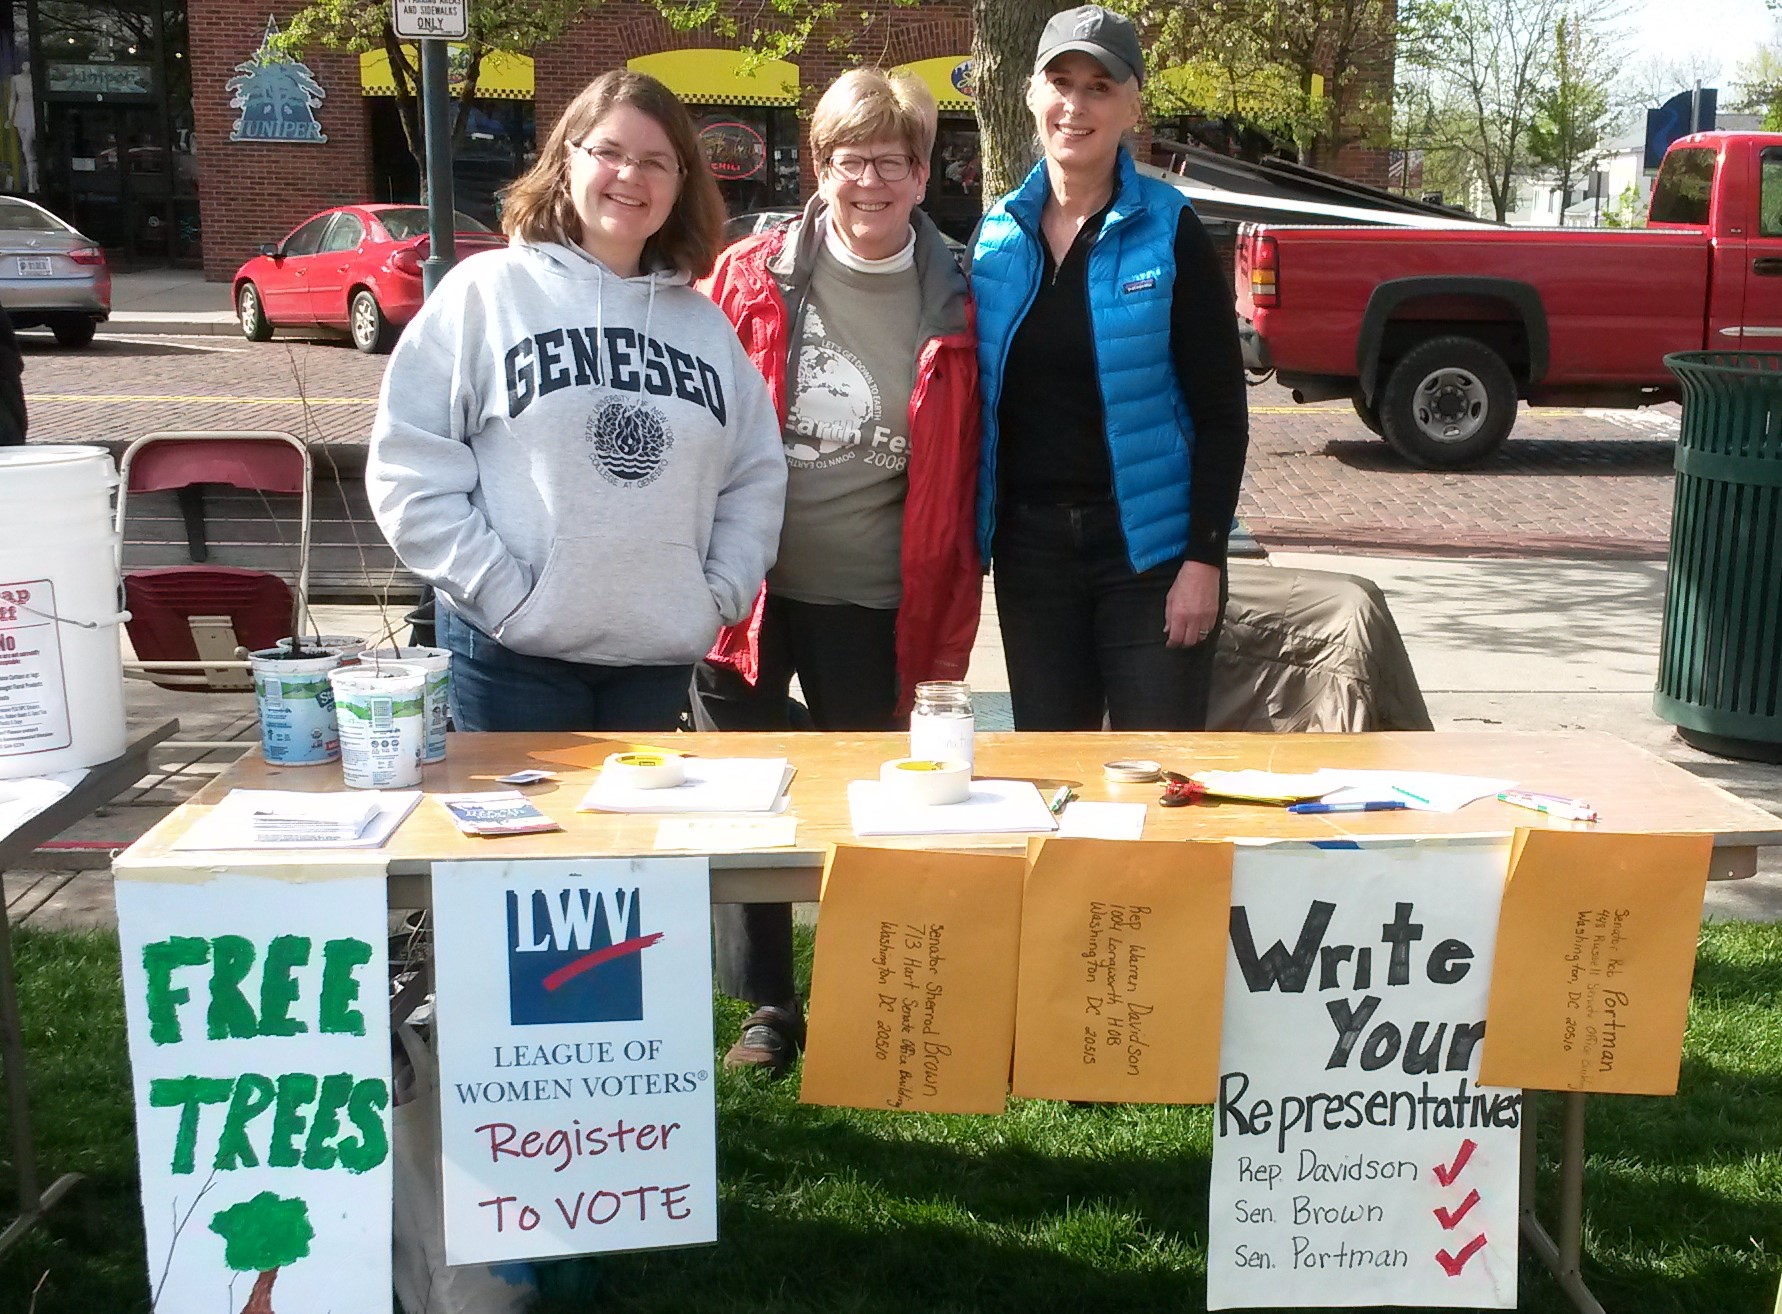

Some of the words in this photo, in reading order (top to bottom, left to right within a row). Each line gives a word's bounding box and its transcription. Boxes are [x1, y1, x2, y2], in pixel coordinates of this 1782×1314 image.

[404, 6, 417, 14] AND
[421, 6, 458, 16] SIDEWALKS
[417, 17, 444, 28] ONLY
[239, 121, 318, 138] JUNIPER
[711, 162, 741, 171] CHILI
[822, 339, 842, 353] LET'S
[843, 349, 857, 363] GET
[505, 327, 727, 428] GENESEO
[854, 360, 874, 384] DOWN
[869, 383, 879, 395] TO
[586, 415, 596, 442] STATE
[592, 395, 630, 414] UNIVERSITY
[650, 406, 668, 424] NEW
[665, 425, 675, 450] YORK
[872, 395, 882, 421] EARTH
[871, 425, 911, 454] Fe
[588, 453, 619, 486] COLLEGE
[622, 481, 633, 489] AT
[636, 458, 669, 488] GENESEO
[787, 458, 815, 470] EARTH
[817, 460, 828, 469] TO
[828, 451, 856, 467] DOWN
[864, 450, 907, 471] 2008
[513, 888, 633, 952] LWV
[1108, 904, 1125, 932] 1004
[1127, 905, 1152, 931] Rep
[1612, 909, 1630, 950] Senator
[872, 921, 898, 985] Washington
[905, 923, 926, 950] 713
[929, 923, 945, 975] Senator
[1081, 901, 1106, 983] Washington
[1229, 900, 1474, 993] Write
[903, 957, 922, 990] Hart
[1100, 937, 1123, 1005] Longworth
[1127, 944, 1146, 992] Warren
[1606, 958, 1624, 978] Rob
[143, 934, 373, 1046] FREE
[878, 993, 897, 1012] DC
[1085, 995, 1103, 1016] DC
[1567, 991, 1582, 1010] DC
[900, 997, 918, 1033] Senate
[923, 981, 943, 1035] Sherrod
[875, 1020, 892, 1061] 20510
[1083, 1026, 1096, 1065] 20515
[1106, 1016, 1124, 1046] HOB
[1325, 995, 1487, 1075] Your
[1563, 1017, 1577, 1052] 20510
[1599, 988, 1629, 1073] Portman
[494, 1041, 614, 1068] LEAGUE
[623, 1039, 663, 1061] OF
[899, 1037, 916, 1067] Office
[923, 1041, 952, 1097] Brown
[455, 1078, 572, 1104] WOMEN
[886, 1069, 913, 1108] Building
[150, 1072, 389, 1175] TREES
[1219, 1071, 1523, 1153] Representatives
[474, 1119, 681, 1172] Register
[1238, 1156, 1283, 1190] Rep.
[1296, 1149, 1418, 1181] Davidson
[479, 1196, 540, 1232] To
[555, 1183, 691, 1230] VOTE
[1234, 1200, 1276, 1223] Sen.
[1292, 1195, 1384, 1225] Brown
[1234, 1244, 1276, 1268] Sen.
[1291, 1236, 1408, 1269] Portman
